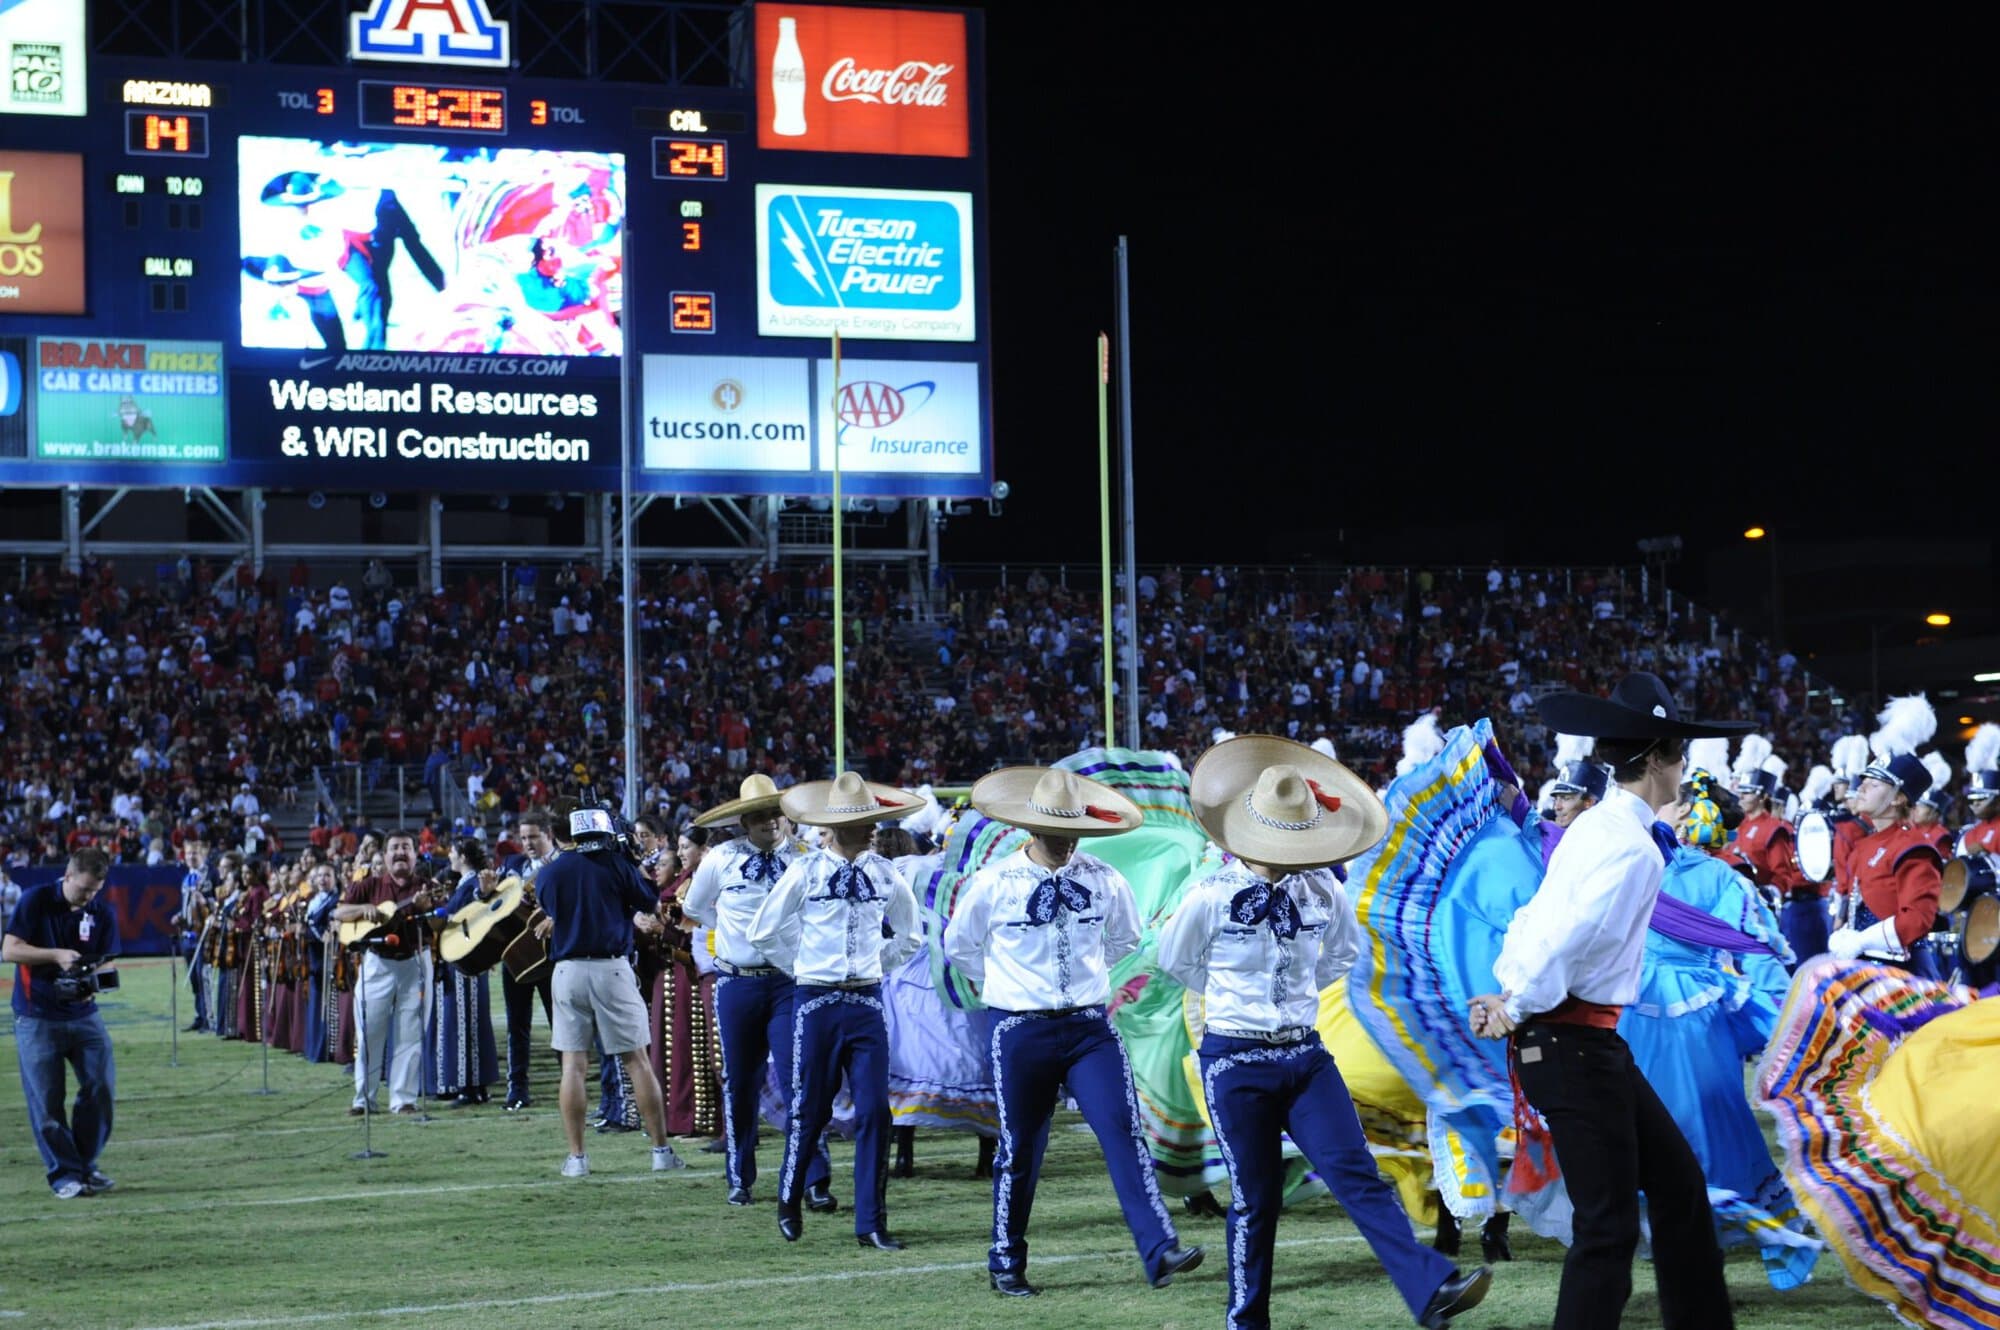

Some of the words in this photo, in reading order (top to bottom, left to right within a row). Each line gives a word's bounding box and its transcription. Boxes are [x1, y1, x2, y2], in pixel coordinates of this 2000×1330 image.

[13, 70, 61, 93] 10
[123, 80, 211, 107] ARIZONA
[821, 57, 955, 107] Coca-Cola
[278, 92, 313, 109] TOL
[316, 88, 334, 114] 3
[393, 86, 503, 129] 9:26
[530, 100, 547, 125] 3
[551, 107, 585, 124] TOL
[146, 115, 189, 151] 14
[669, 110, 708, 132] CAL
[669, 142, 725, 176] 24
[166, 177, 182, 195] TO
[183, 178, 203, 195] GO
[683, 223, 700, 250] 3
[816, 209, 917, 240] Tucson
[827, 238, 944, 267] Electric
[145, 258, 172, 276] BALL
[174, 258, 193, 276] ON
[839, 266, 944, 294] Power
[672, 296, 712, 329] 25
[769, 315, 779, 325] A
[782, 315, 849, 328] UniSource
[853, 316, 897, 332] Energy
[902, 318, 963, 333] Company
[335, 354, 568, 376] ARIZONAATHLETICS.COM
[42, 373, 81, 391] CAR
[86, 374, 134, 392] CARE
[139, 376, 218, 395] CENTERS
[269, 379, 421, 412] Westland
[431, 383, 598, 417] Resources
[838, 381, 901, 428] AAA
[650, 416, 806, 441] tucson.com
[43, 441, 219, 458] www.brakemax.com
[281, 426, 308, 457] &
[314, 426, 387, 458] WRI
[396, 428, 590, 461] Construction
[870, 436, 969, 455] Insurance
